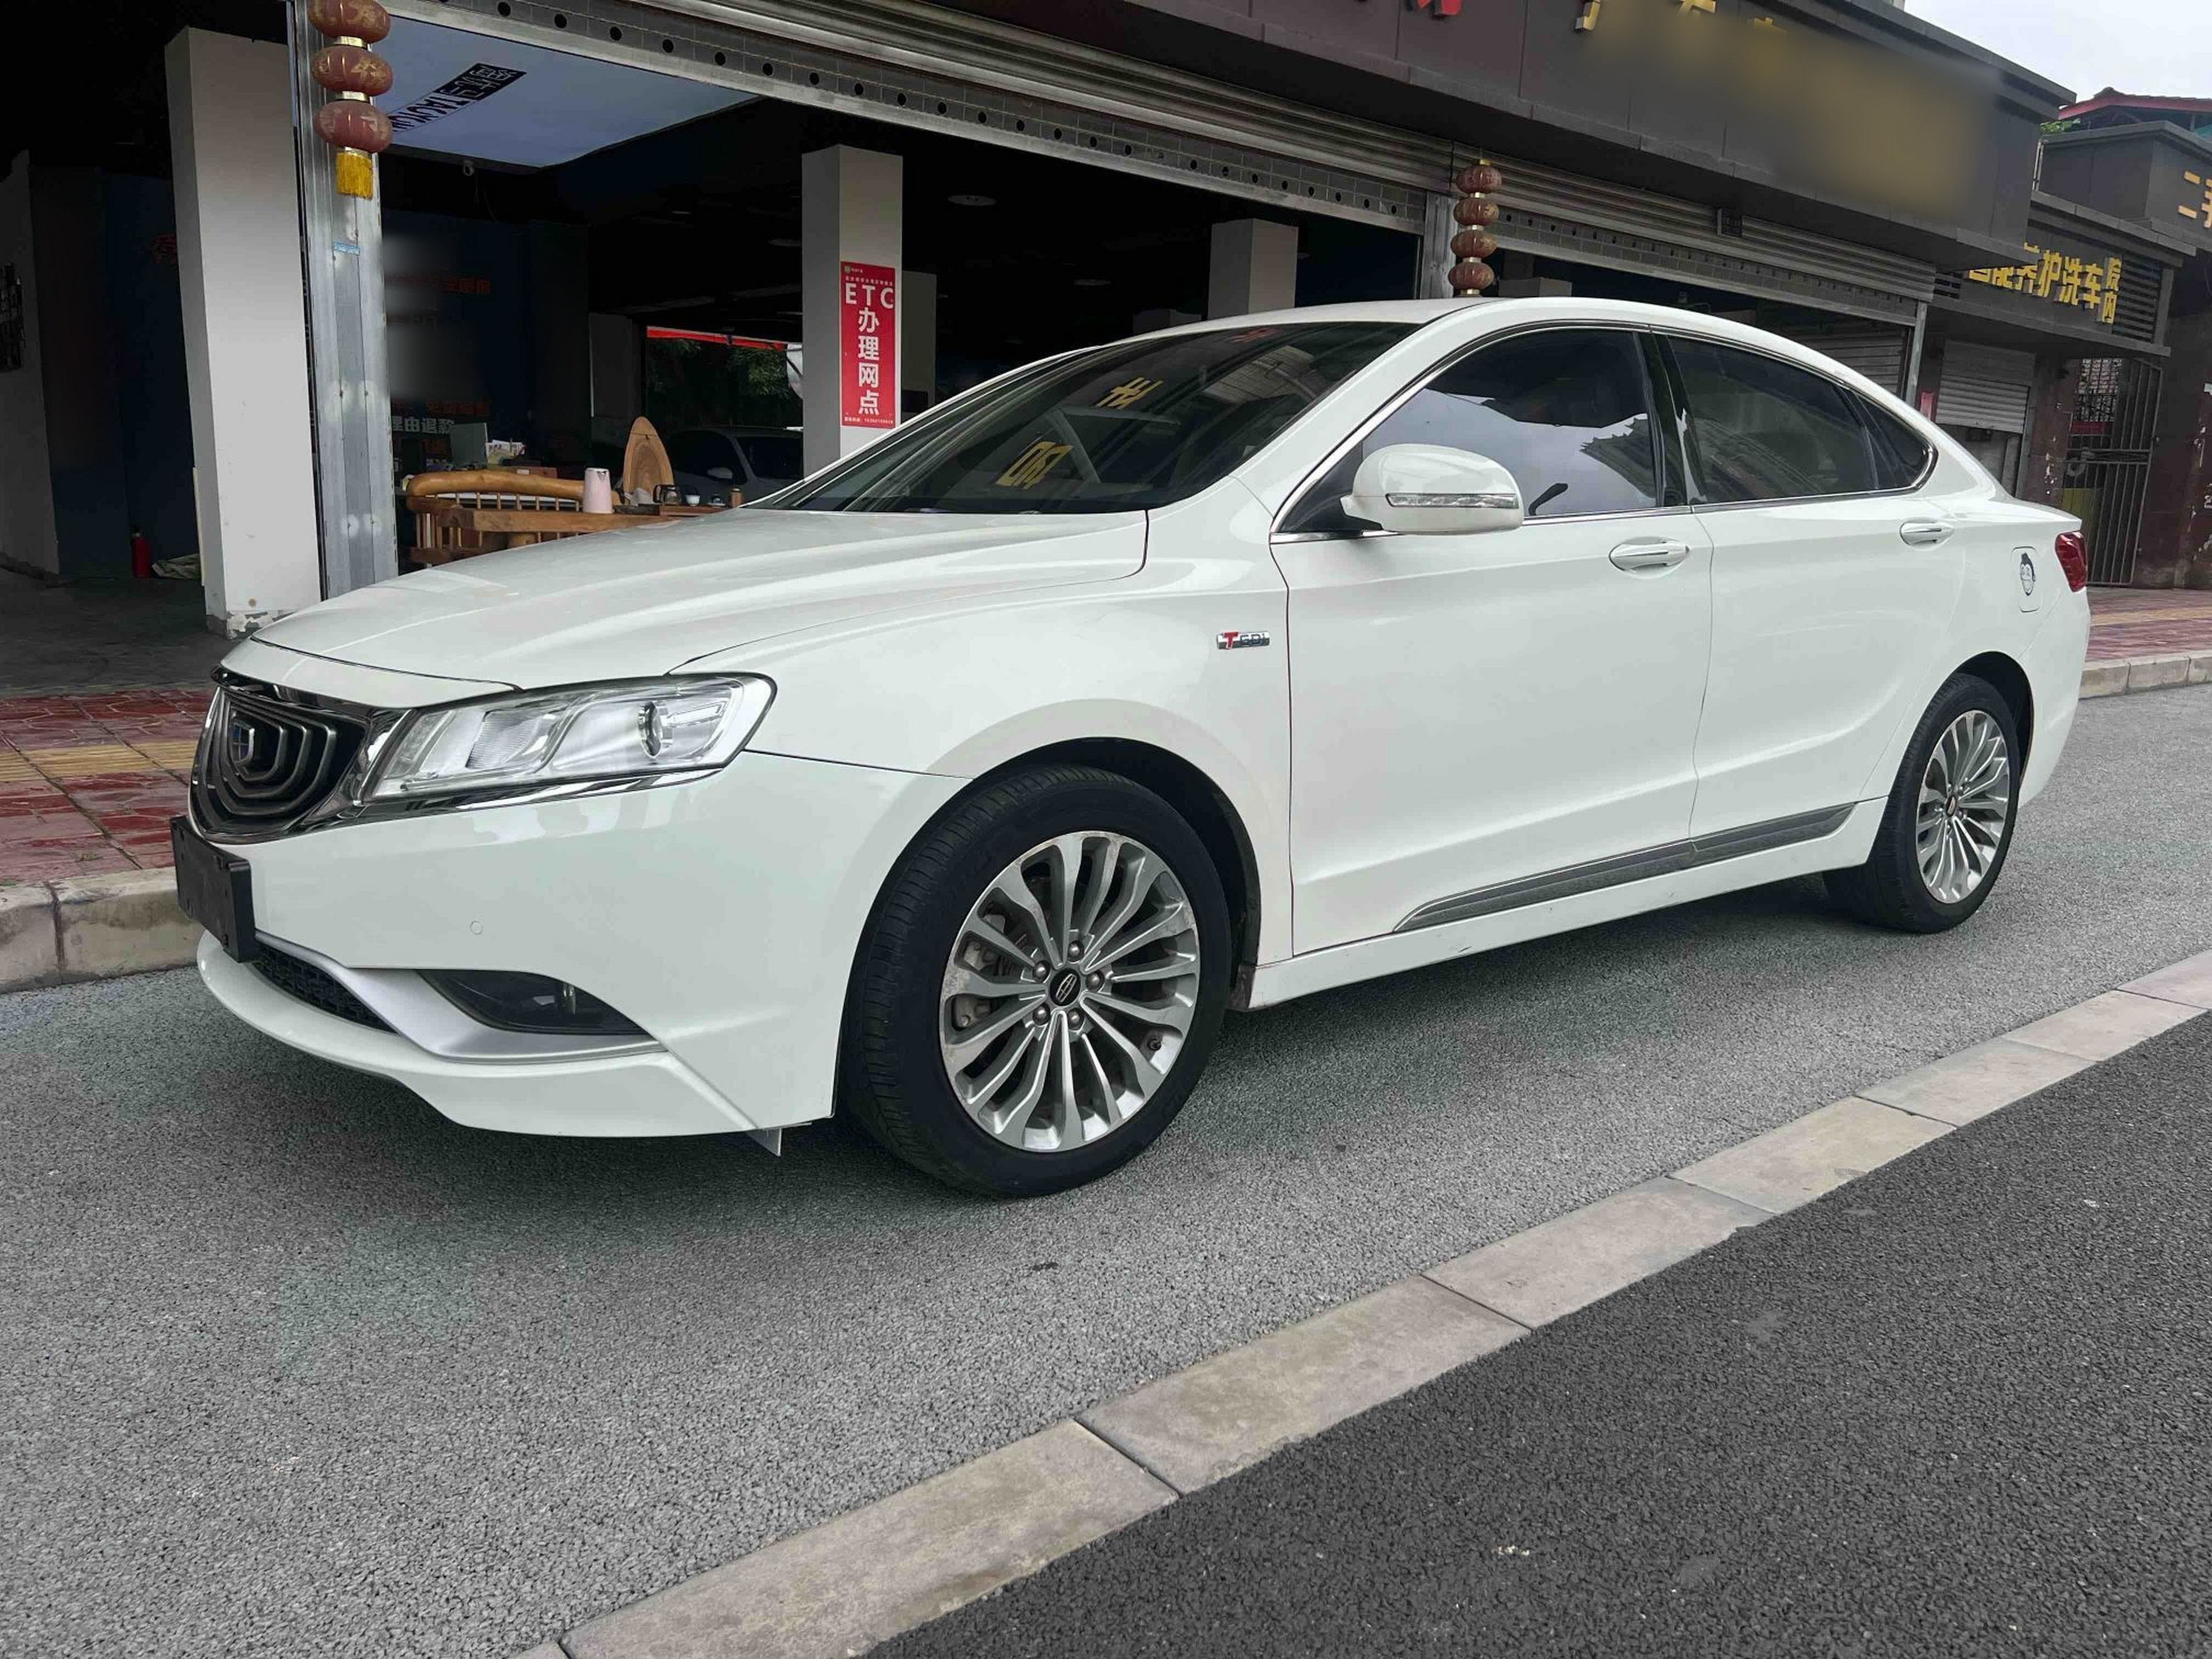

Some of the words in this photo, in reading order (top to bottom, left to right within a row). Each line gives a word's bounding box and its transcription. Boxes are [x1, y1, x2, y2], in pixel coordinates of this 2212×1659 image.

[845, 283, 894, 309] ETC
[858, 307, 880, 415] 办理网点
